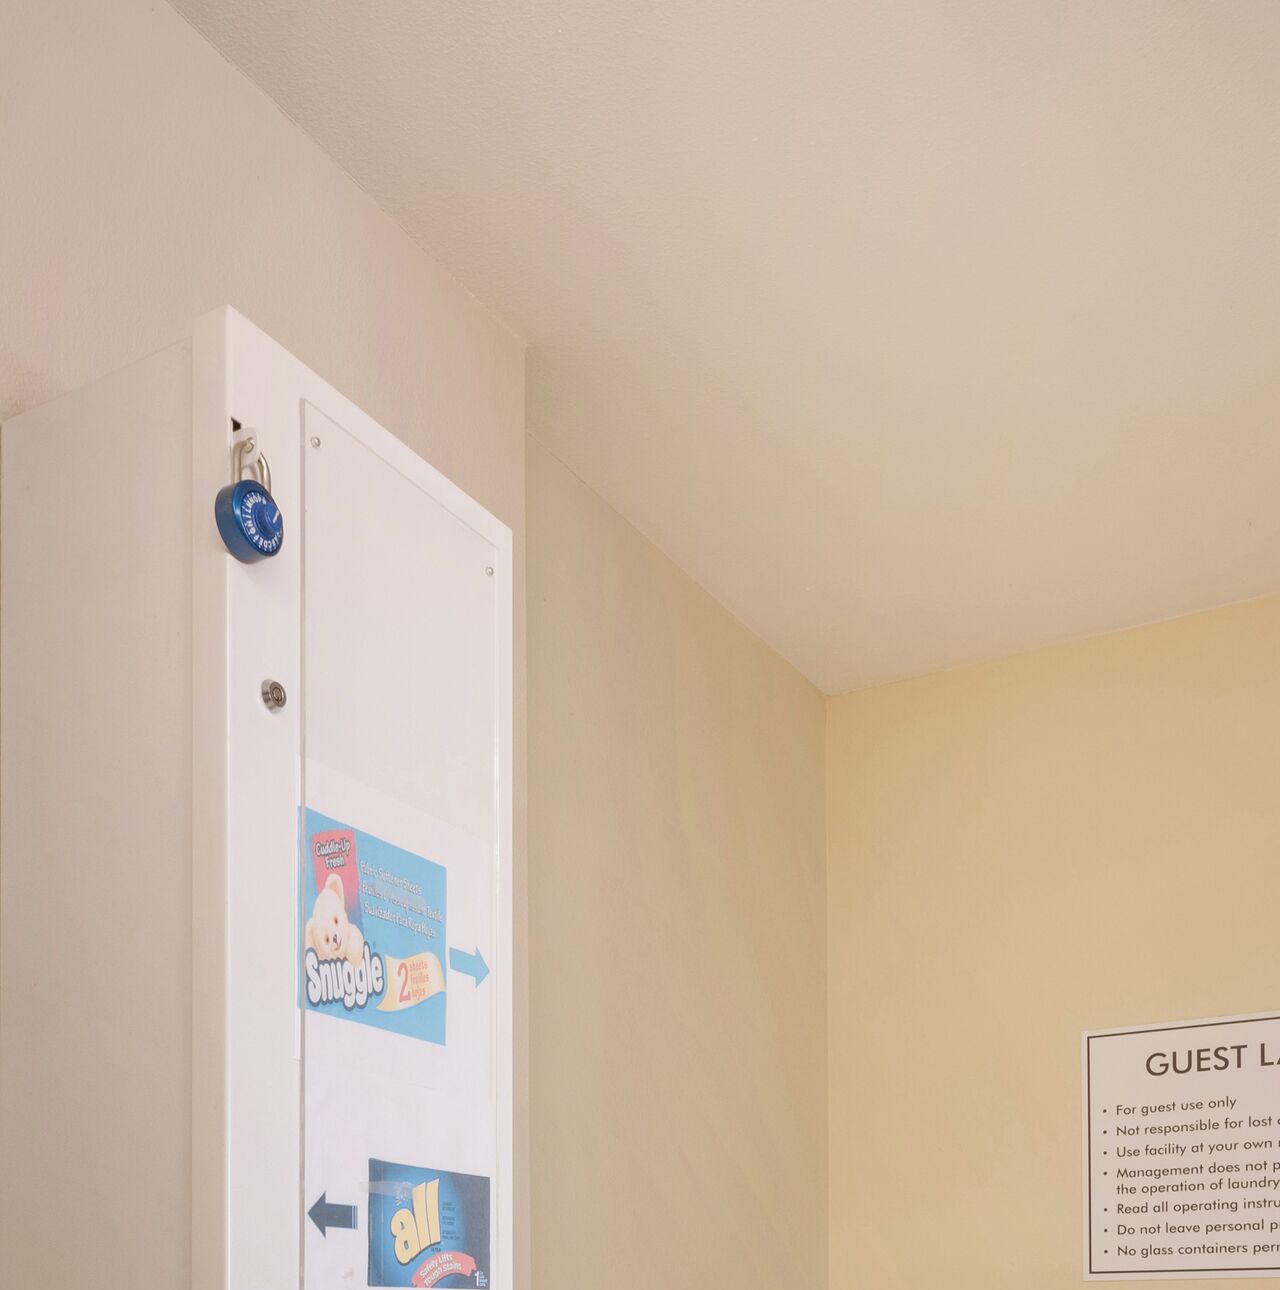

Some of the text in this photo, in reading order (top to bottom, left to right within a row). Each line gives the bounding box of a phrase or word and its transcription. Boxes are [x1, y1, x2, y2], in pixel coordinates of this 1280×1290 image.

[325, 855, 346, 869] Fresh
[305, 942, 384, 1010] Snuggle
[397, 962, 411, 1003] 2
[1145, 1044, 1248, 1077] GUEST
[1116, 1095, 1237, 1117] For guest use only
[1116, 1125, 1140, 1137] Not
[1144, 1118, 1220, 1137] responsible
[1223, 1117, 1244, 1129] for
[1248, 1115, 1273, 1128] lost
[1116, 1146, 1141, 1158] Use
[1144, 1142, 1187, 1157] facility
[1190, 1142, 1204, 1153] at
[1208, 1142, 1239, 1155] your
[1243, 1140, 1273, 1150] own
[1116, 1164, 1204, 1180] Management
[1208, 1161, 1241, 1174] does
[1245, 1160, 1268, 1172] not
[1116, 1183, 1137, 1195] the
[1141, 1181, 1205, 1196] operation
[1209, 1177, 1224, 1191] of
[1227, 1175, 1280, 1191] laundry
[1117, 1201, 1149, 1215] Read
[1152, 1200, 1169, 1213] all
[1173, 1200, 1238, 1215] operating
[390, 1178, 441, 1265] all
[1117, 1224, 1136, 1236] Do
[1140, 1223, 1161, 1235] not
[1165, 1221, 1201, 1234] leave
[1205, 1218, 1265, 1235] personal
[1117, 1245, 1137, 1257] No
[1140, 1243, 1174, 1259] glass
[1177, 1242, 1249, 1255] containers
